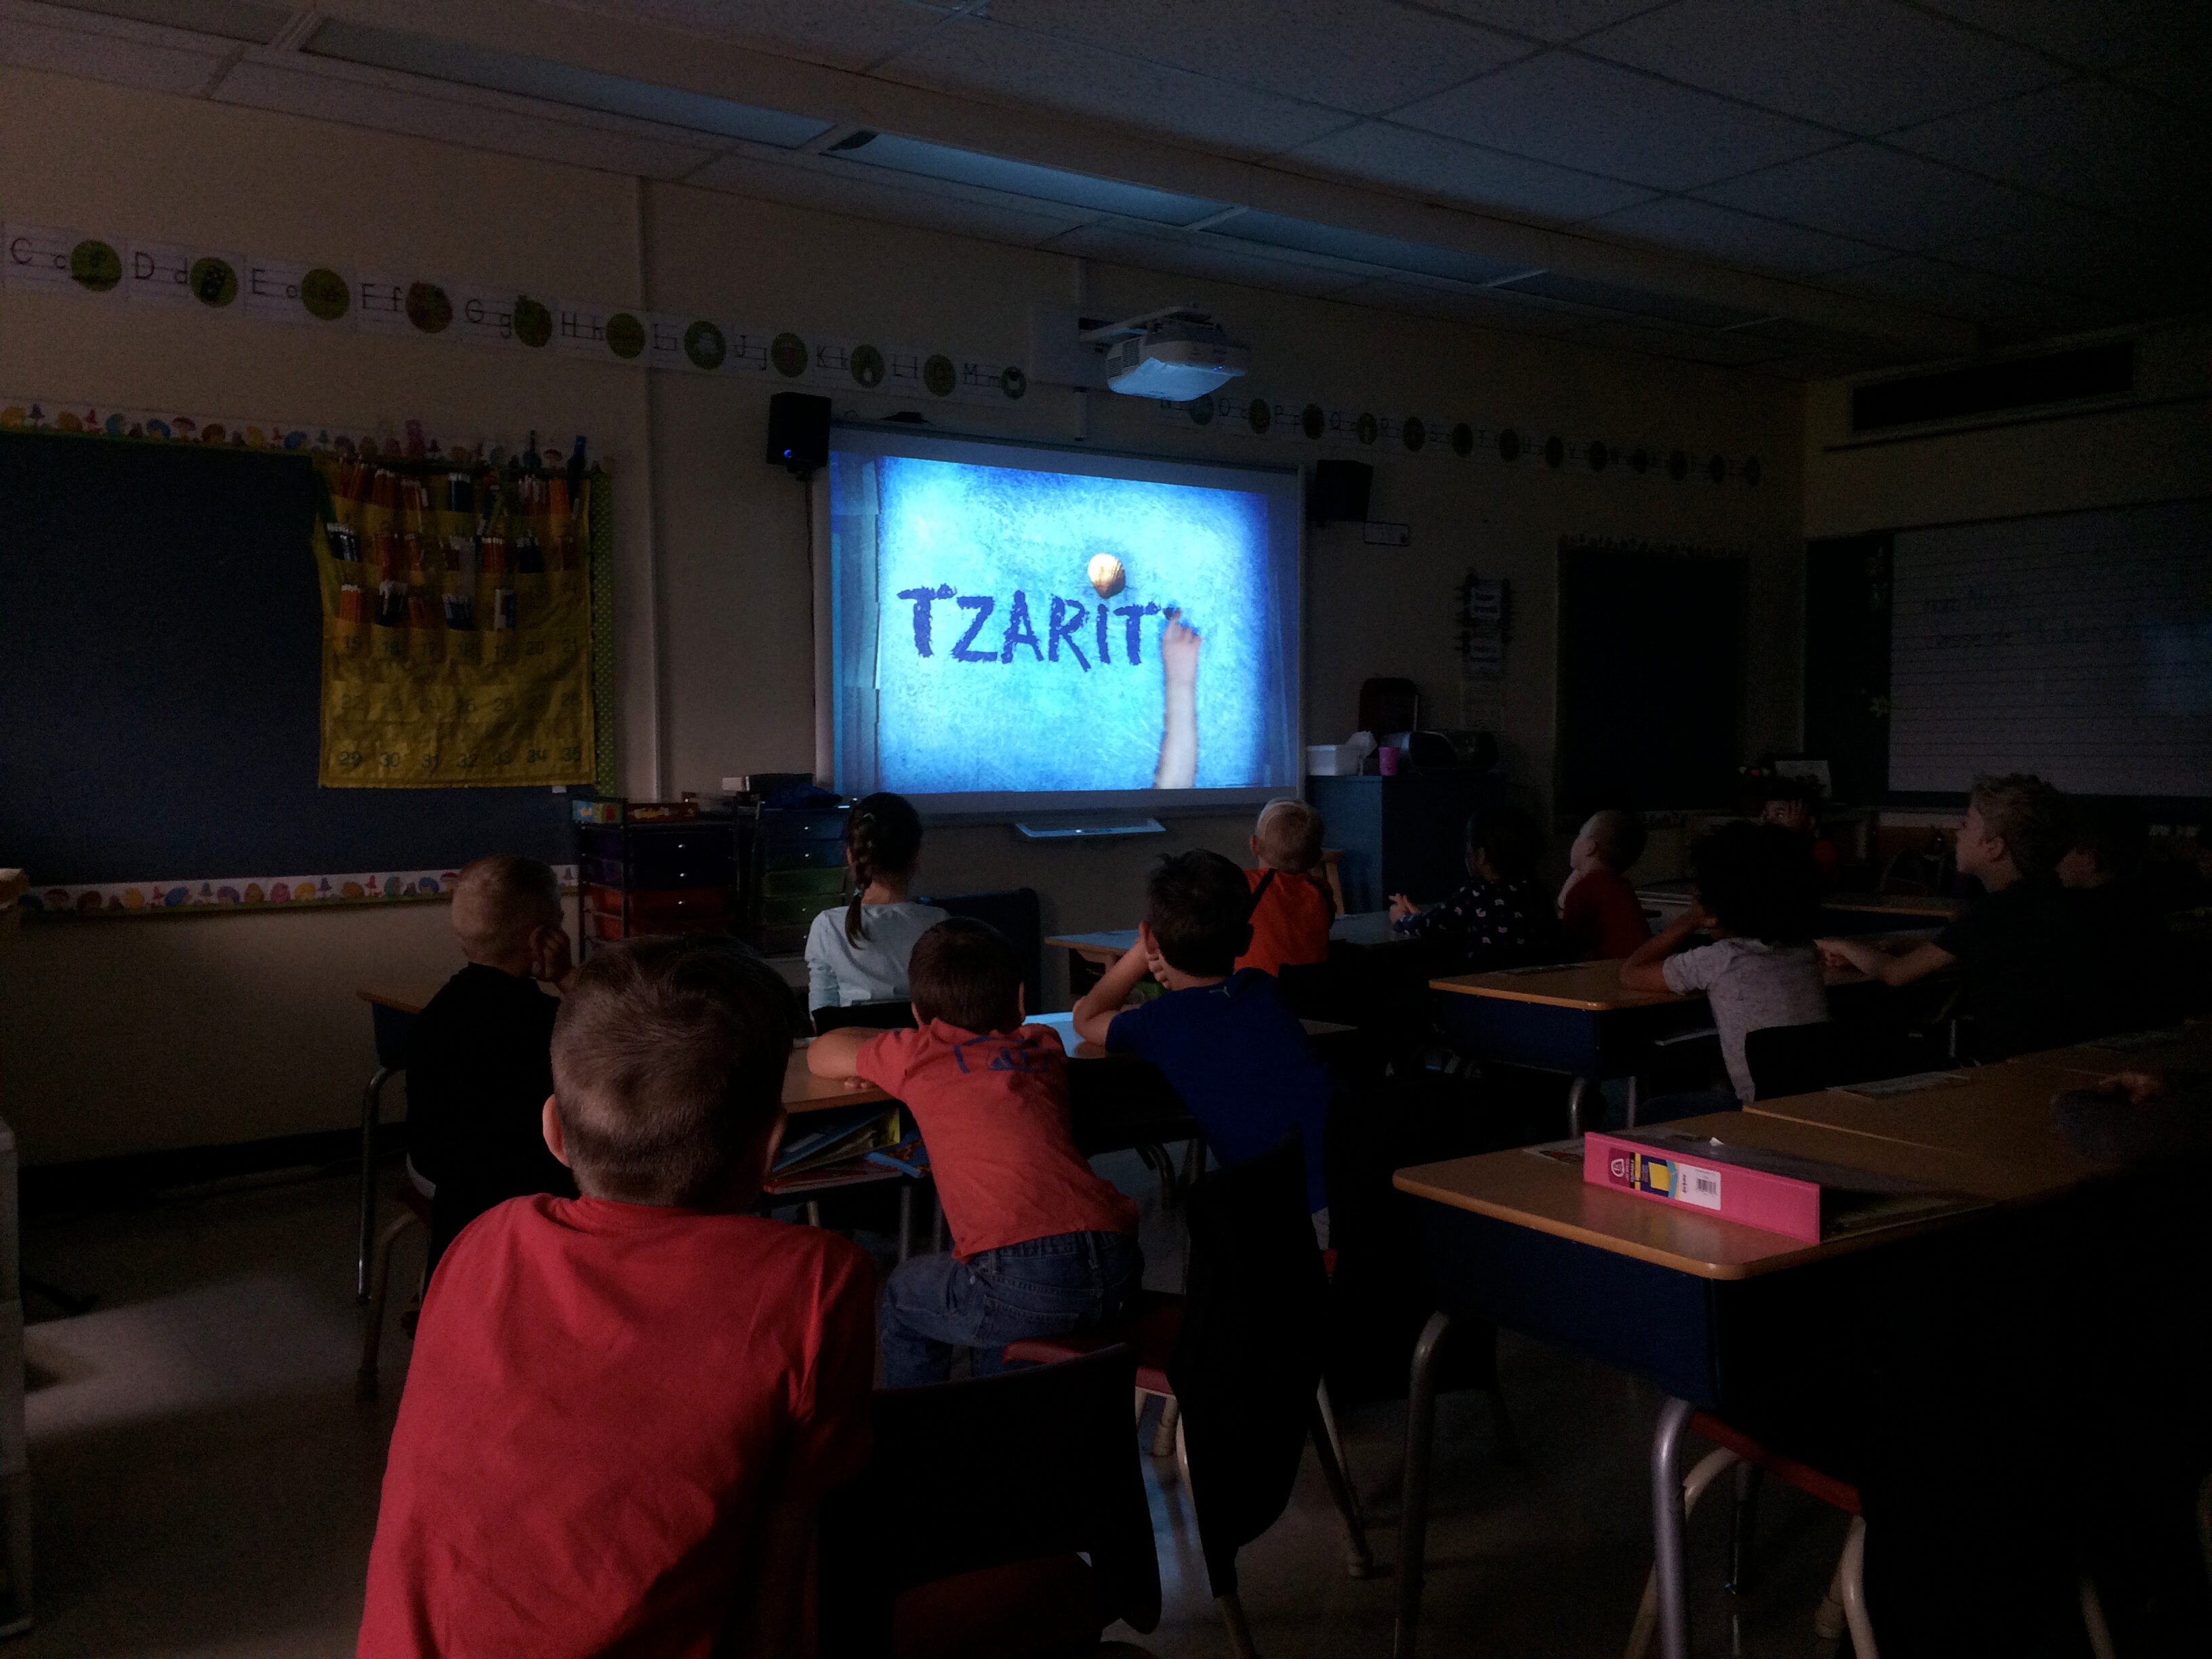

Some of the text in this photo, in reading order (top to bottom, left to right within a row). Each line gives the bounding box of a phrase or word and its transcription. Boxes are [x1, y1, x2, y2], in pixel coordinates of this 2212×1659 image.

[10, 237, 33, 265] C
[135, 251, 188, 285] D d
[251, 268, 298, 299] E e
[361, 283, 403, 312] F f
[465, 299, 484, 323] G
[562, 312, 576, 337] H
[817, 345, 827, 368] K
[340, 751, 362, 766] 29
[380, 752, 401, 767] 30
